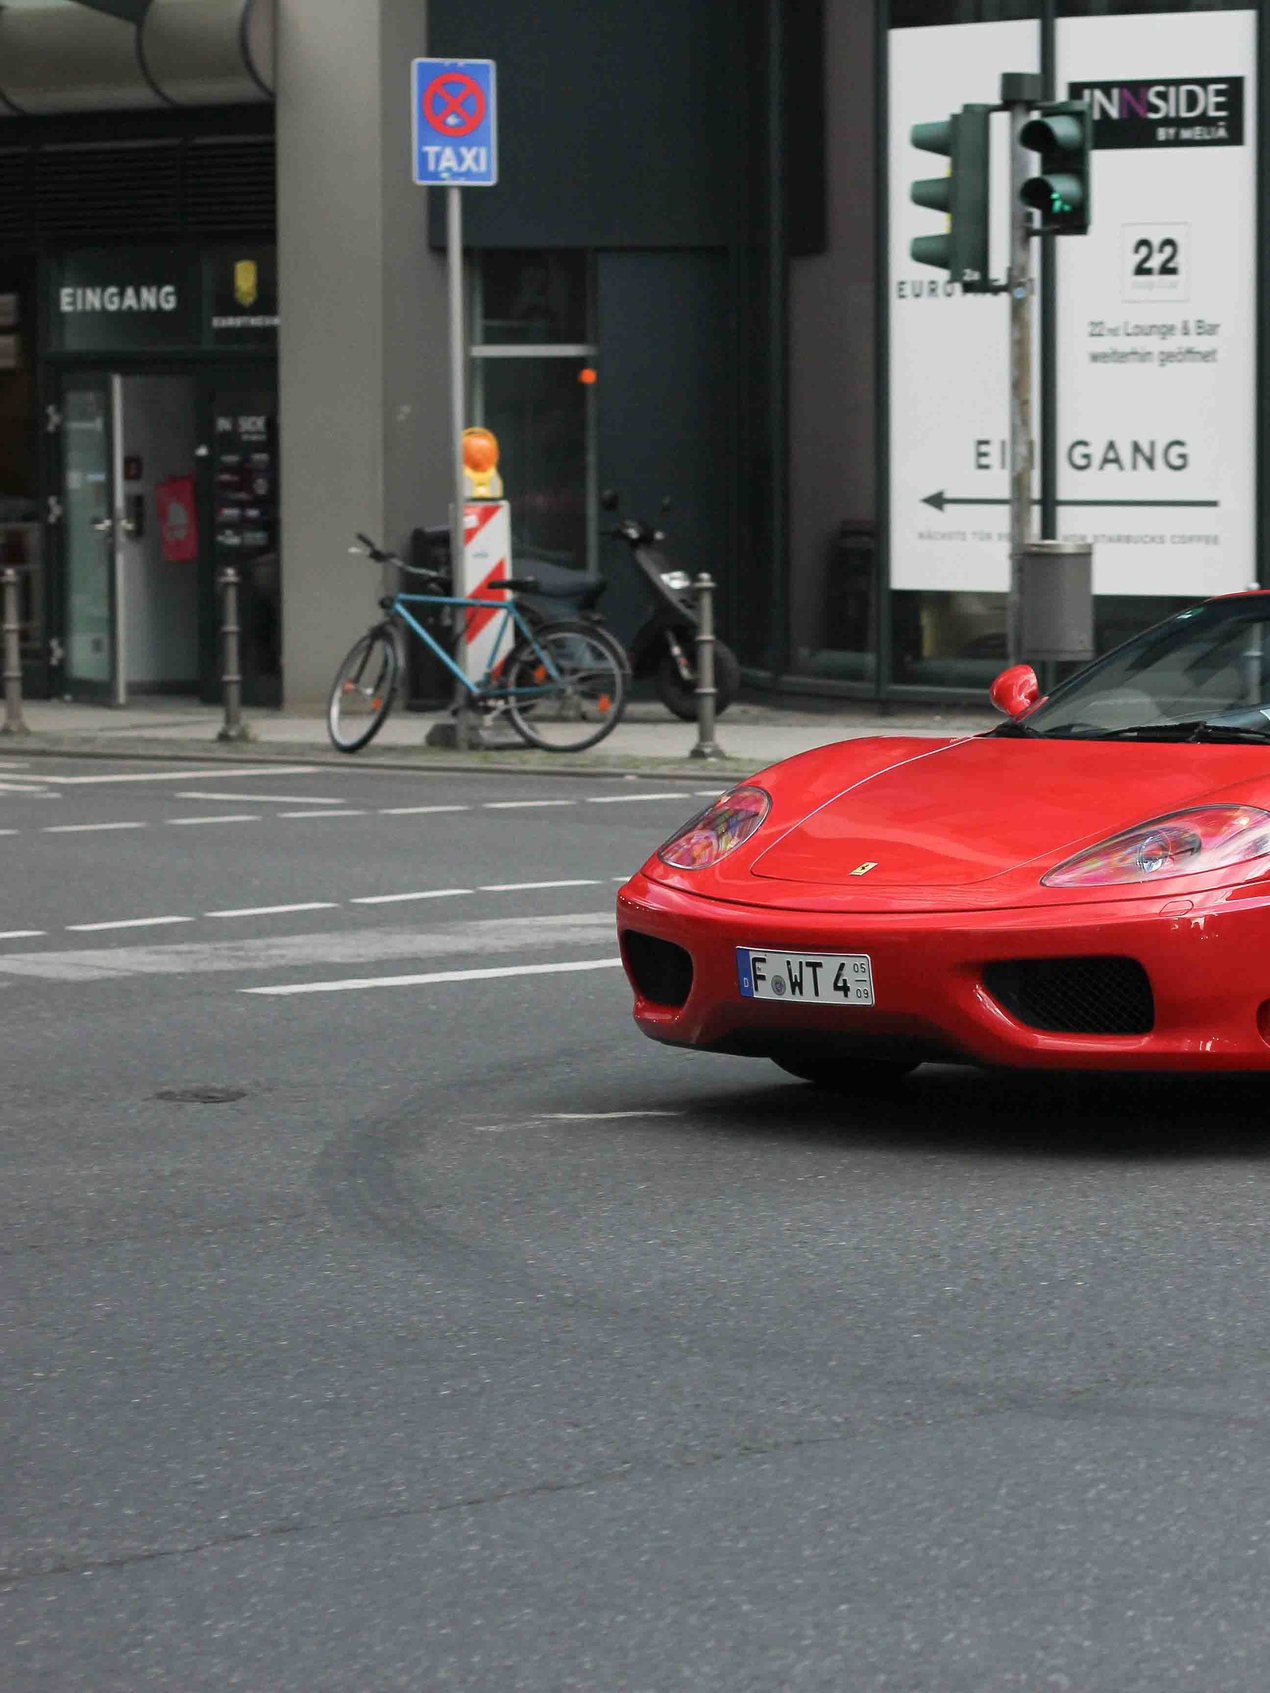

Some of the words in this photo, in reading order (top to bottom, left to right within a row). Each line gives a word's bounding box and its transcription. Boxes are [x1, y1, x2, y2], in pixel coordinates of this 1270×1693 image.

[1156, 127, 1177, 141] BY
[422, 146, 488, 172] TAXI
[1133, 238, 1179, 276] 22
[59, 285, 177, 312] EINGANG
[1123, 320, 1176, 340] Lounge
[1195, 319, 1221, 336] Bar
[1089, 346, 1154, 363] weiterhin
[1157, 345, 1218, 366] geöffnet
[974, 438, 1189, 472] EIGANG
[1170, 534, 1219, 545] COFFEE
[743, 977, 750, 988] D
[751, 956, 768, 992] F
[786, 959, 824, 998] WT
[833, 961, 851, 999] 4
[856, 987, 869, 999] 09
